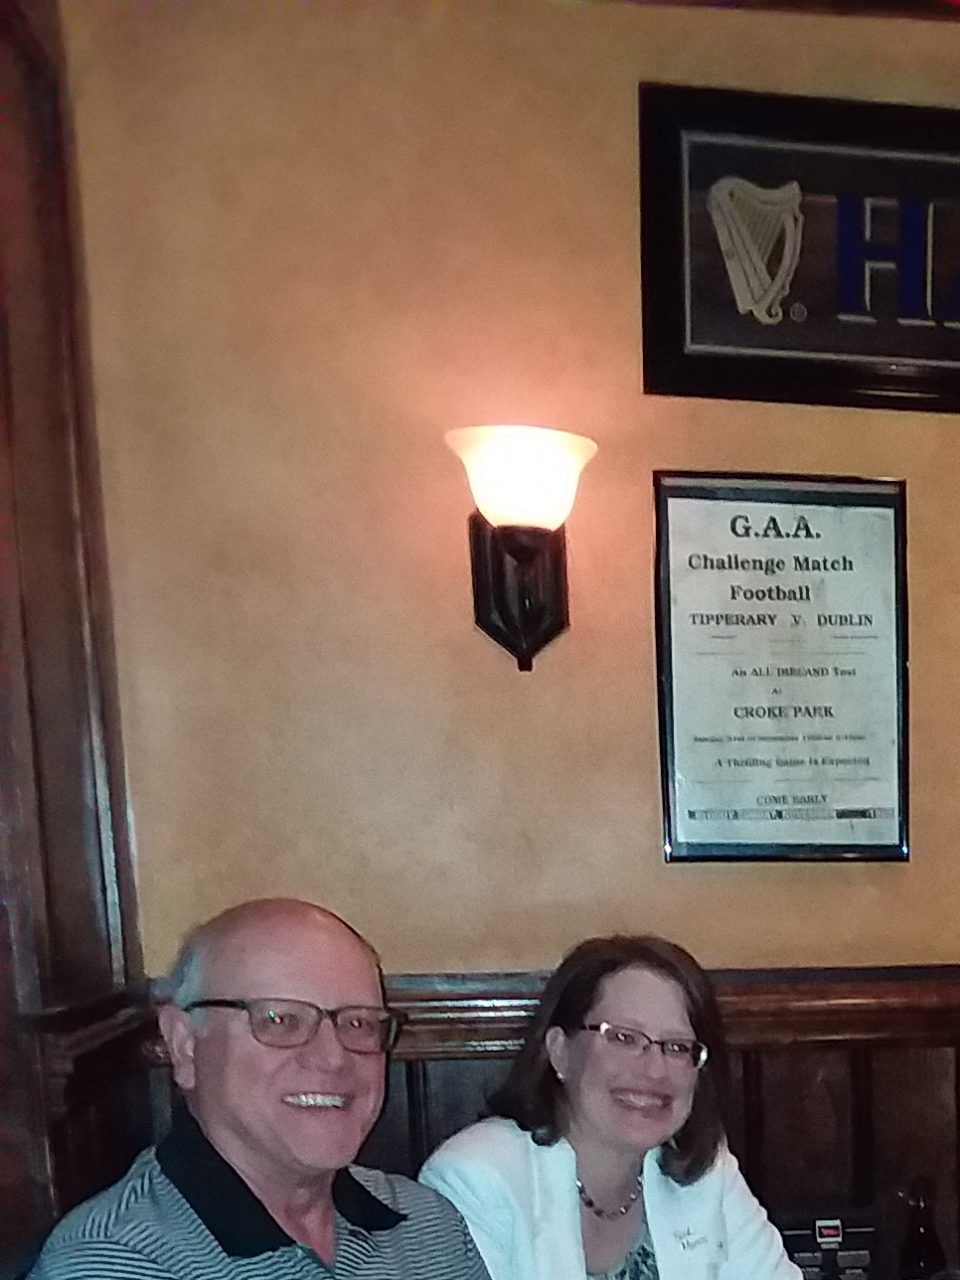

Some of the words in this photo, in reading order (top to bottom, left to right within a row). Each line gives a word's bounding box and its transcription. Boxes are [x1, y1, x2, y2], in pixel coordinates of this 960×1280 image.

[730, 514, 822, 540] G.A.A.
[687, 553, 786, 575] Challenge
[793, 555, 854, 573] Match
[730, 584, 811, 602] Football
[689, 613, 777, 626] TIPPERARY
[817, 613, 874, 627] DUBLIN
[733, 706, 788, 719] CROKE
[793, 705, 835, 718] PARK
